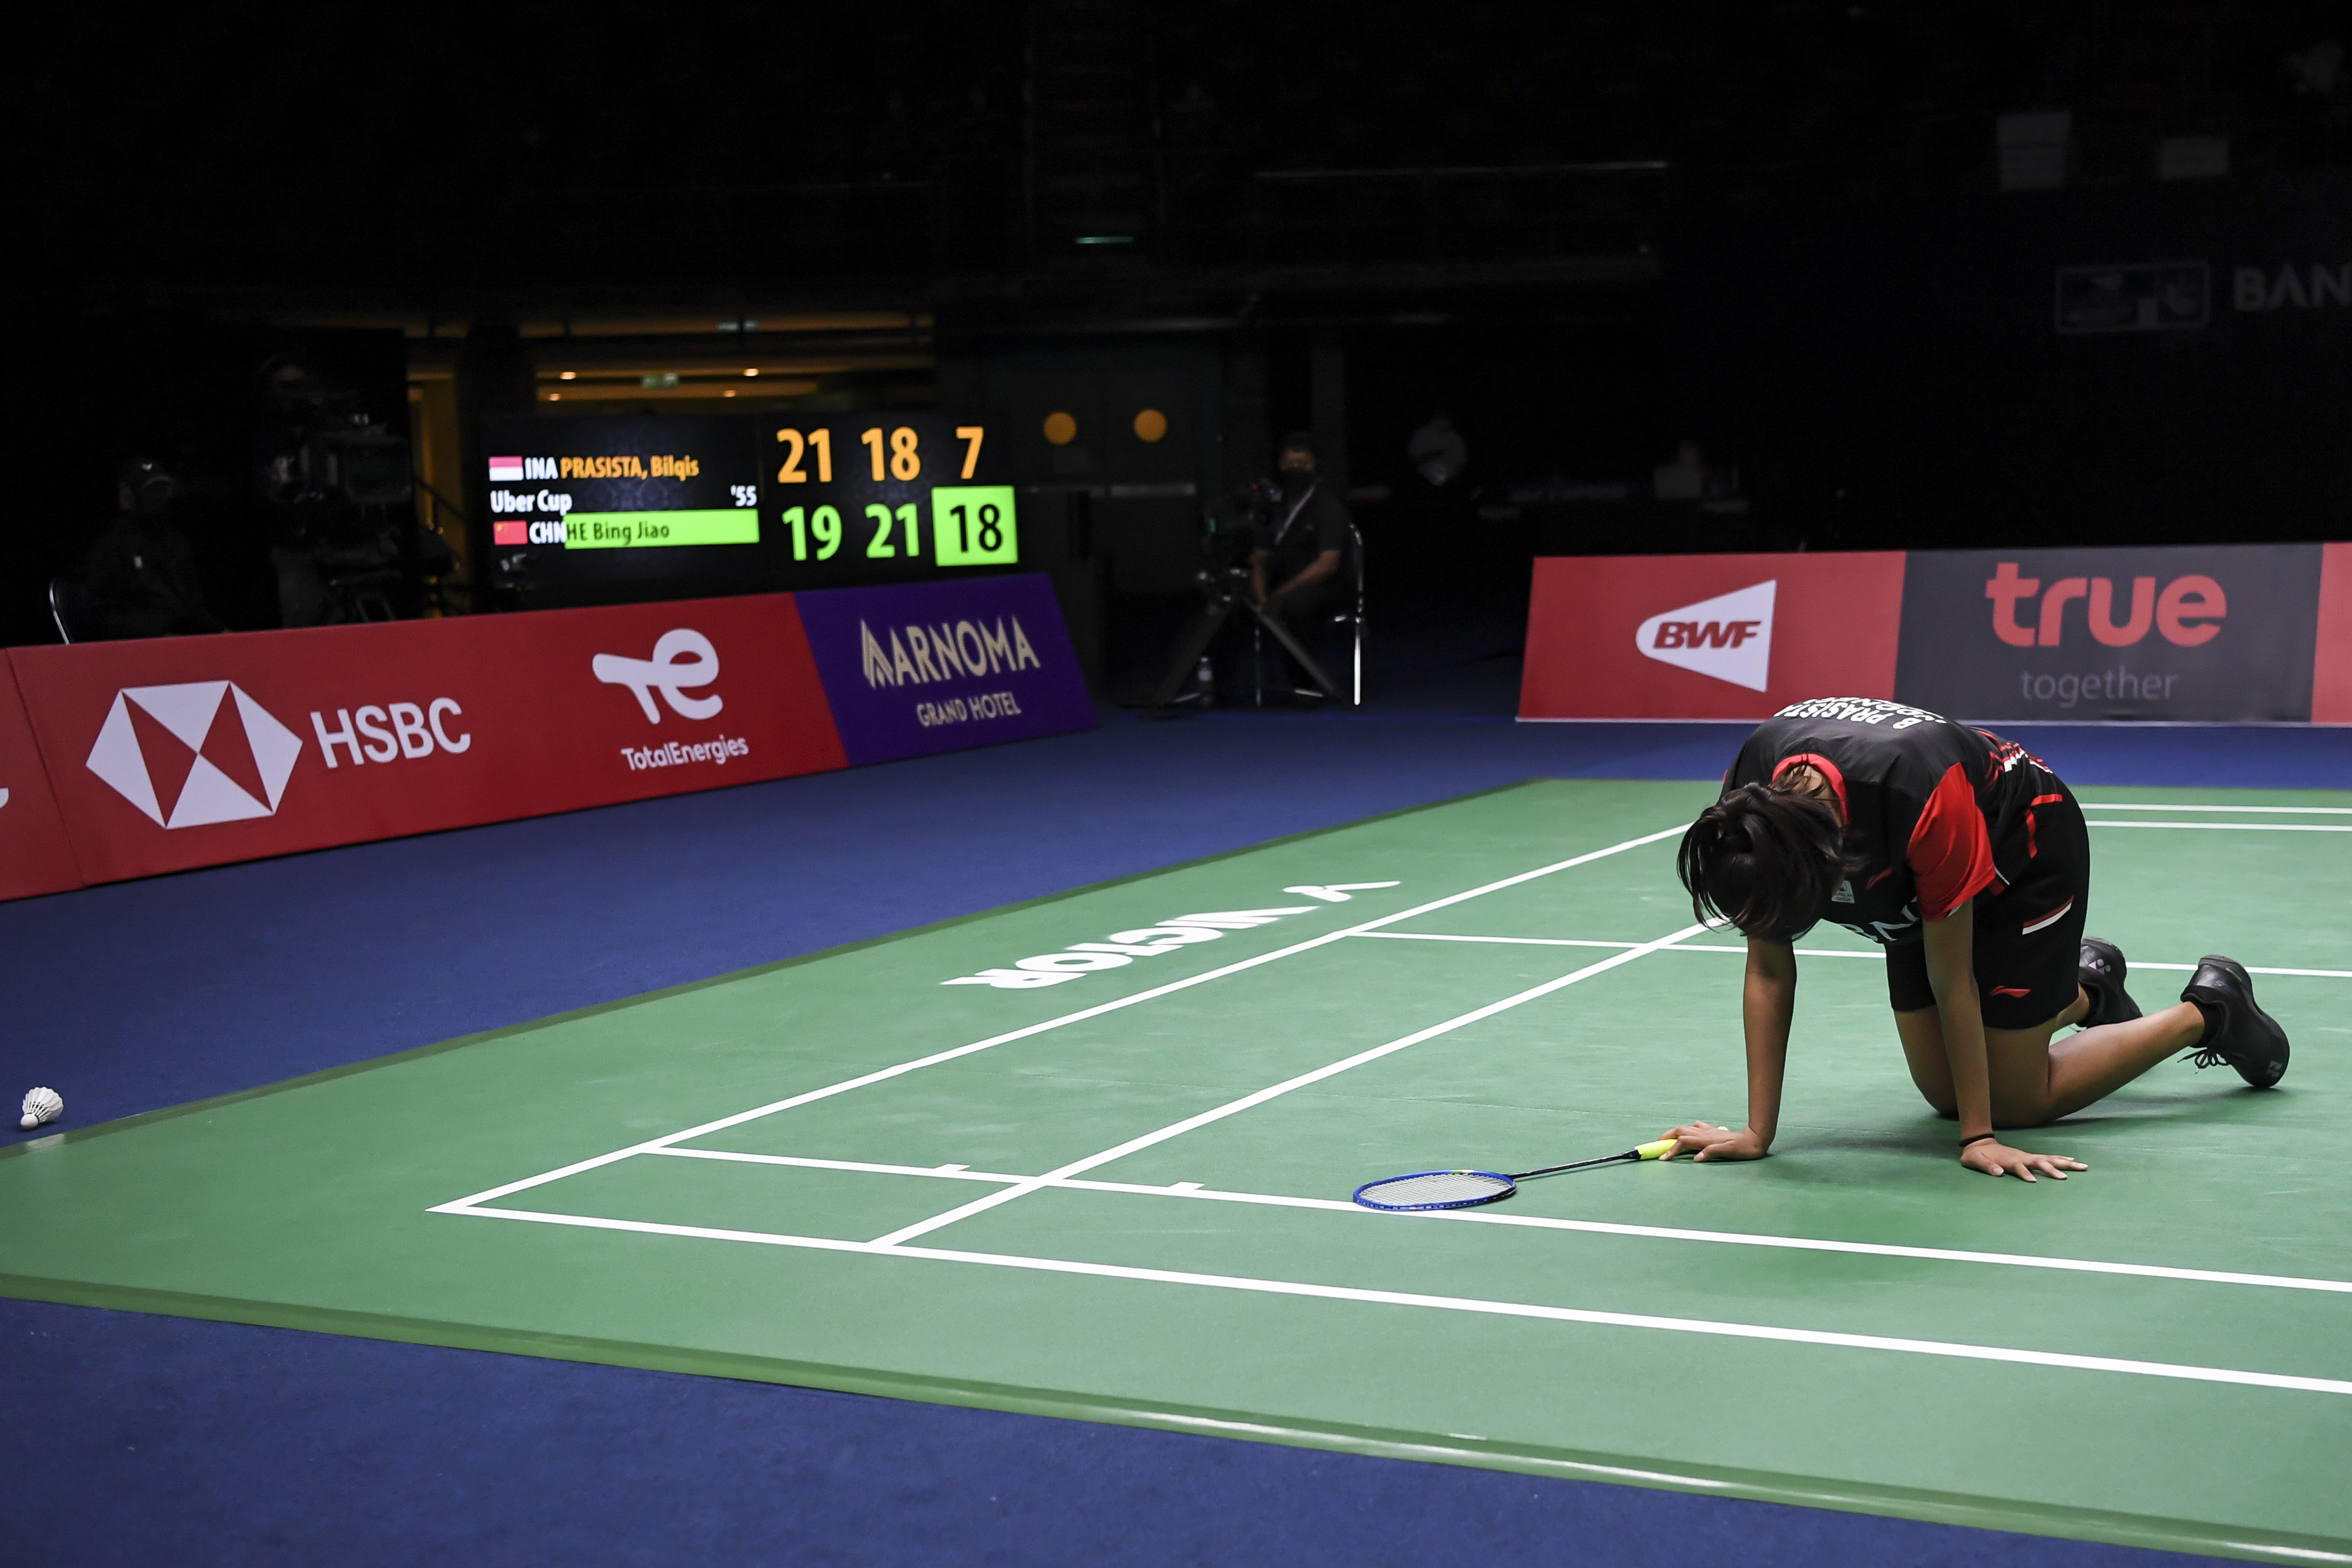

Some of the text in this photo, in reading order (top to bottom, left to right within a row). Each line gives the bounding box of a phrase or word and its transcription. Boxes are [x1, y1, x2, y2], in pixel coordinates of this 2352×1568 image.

[524, 455, 699, 482] INA PRASISTA, Bilqis
[777, 427, 984, 483] 21 18 7
[490, 485, 757, 516] Uber Cup '55
[529, 521, 670, 545] CHN HE Bing Jiao
[783, 503, 1003, 561] 19 21 18
[1984, 562, 2226, 647] true
[1652, 620, 1762, 650] BWF
[2020, 664, 2178, 708] together
[917, 691, 1021, 727] GRAND HOTEL
[1773, 703, 1894, 724] PRASISTA
[310, 697, 470, 768] HSBC
[622, 734, 749, 771] TotalEnergies
[940, 906, 1319, 988] VICTOR
